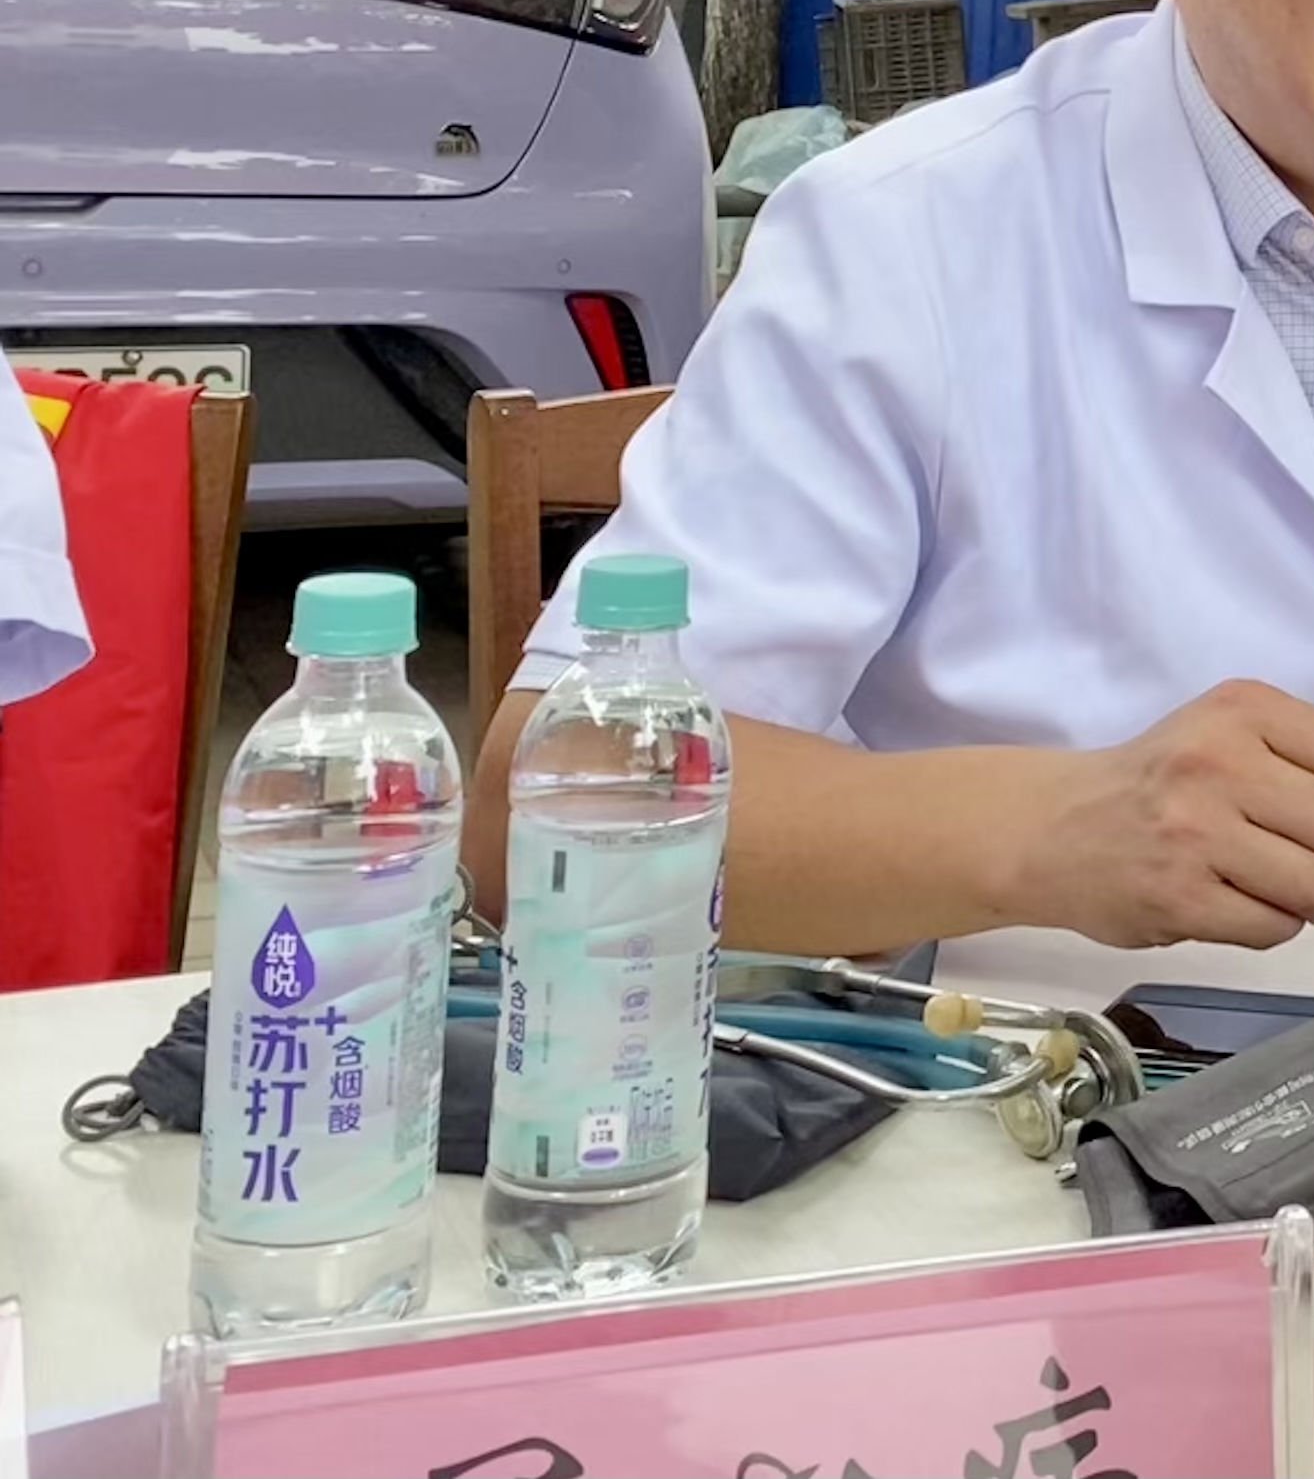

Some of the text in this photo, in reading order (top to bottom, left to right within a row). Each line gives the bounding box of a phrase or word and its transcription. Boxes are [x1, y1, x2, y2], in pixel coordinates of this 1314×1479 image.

[263, 932, 301, 998] 纯悦
[241, 1013, 311, 1203] 苏打水
[328, 1035, 366, 1135] 含烟酸
